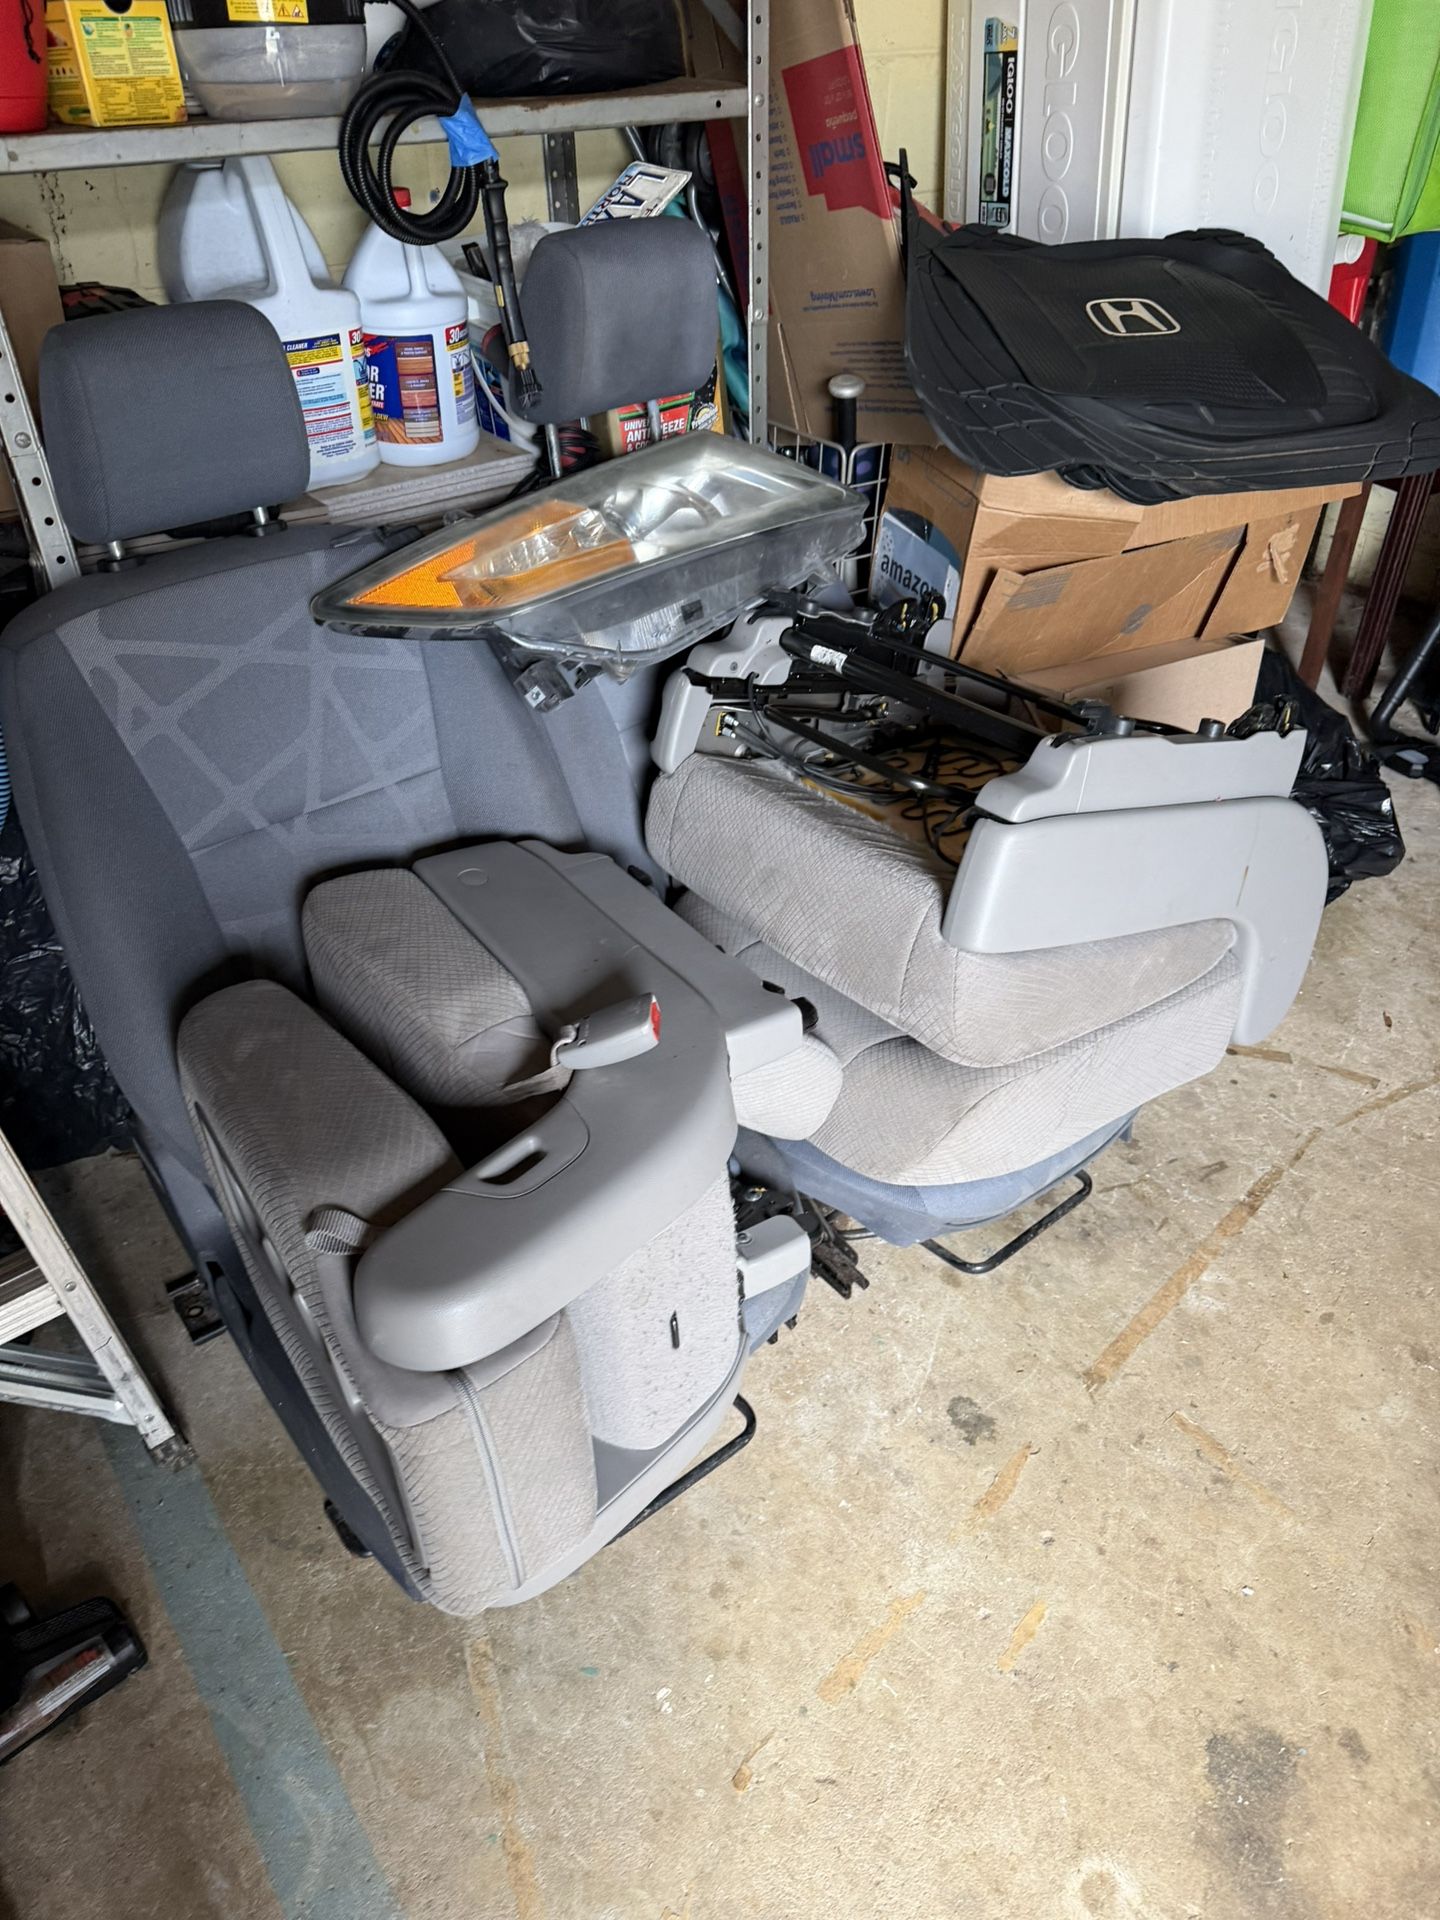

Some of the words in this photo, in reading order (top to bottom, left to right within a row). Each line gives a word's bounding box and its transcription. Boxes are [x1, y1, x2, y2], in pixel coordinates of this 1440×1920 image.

[1006, 56, 1016, 113] IGLOO
[808, 132, 865, 179] small
[1002, 127, 1012, 197] MAXCOLD
[286, 342, 308, 352] CLEANER
[351, 331, 361, 345] 30
[448, 326, 460, 345] 30
